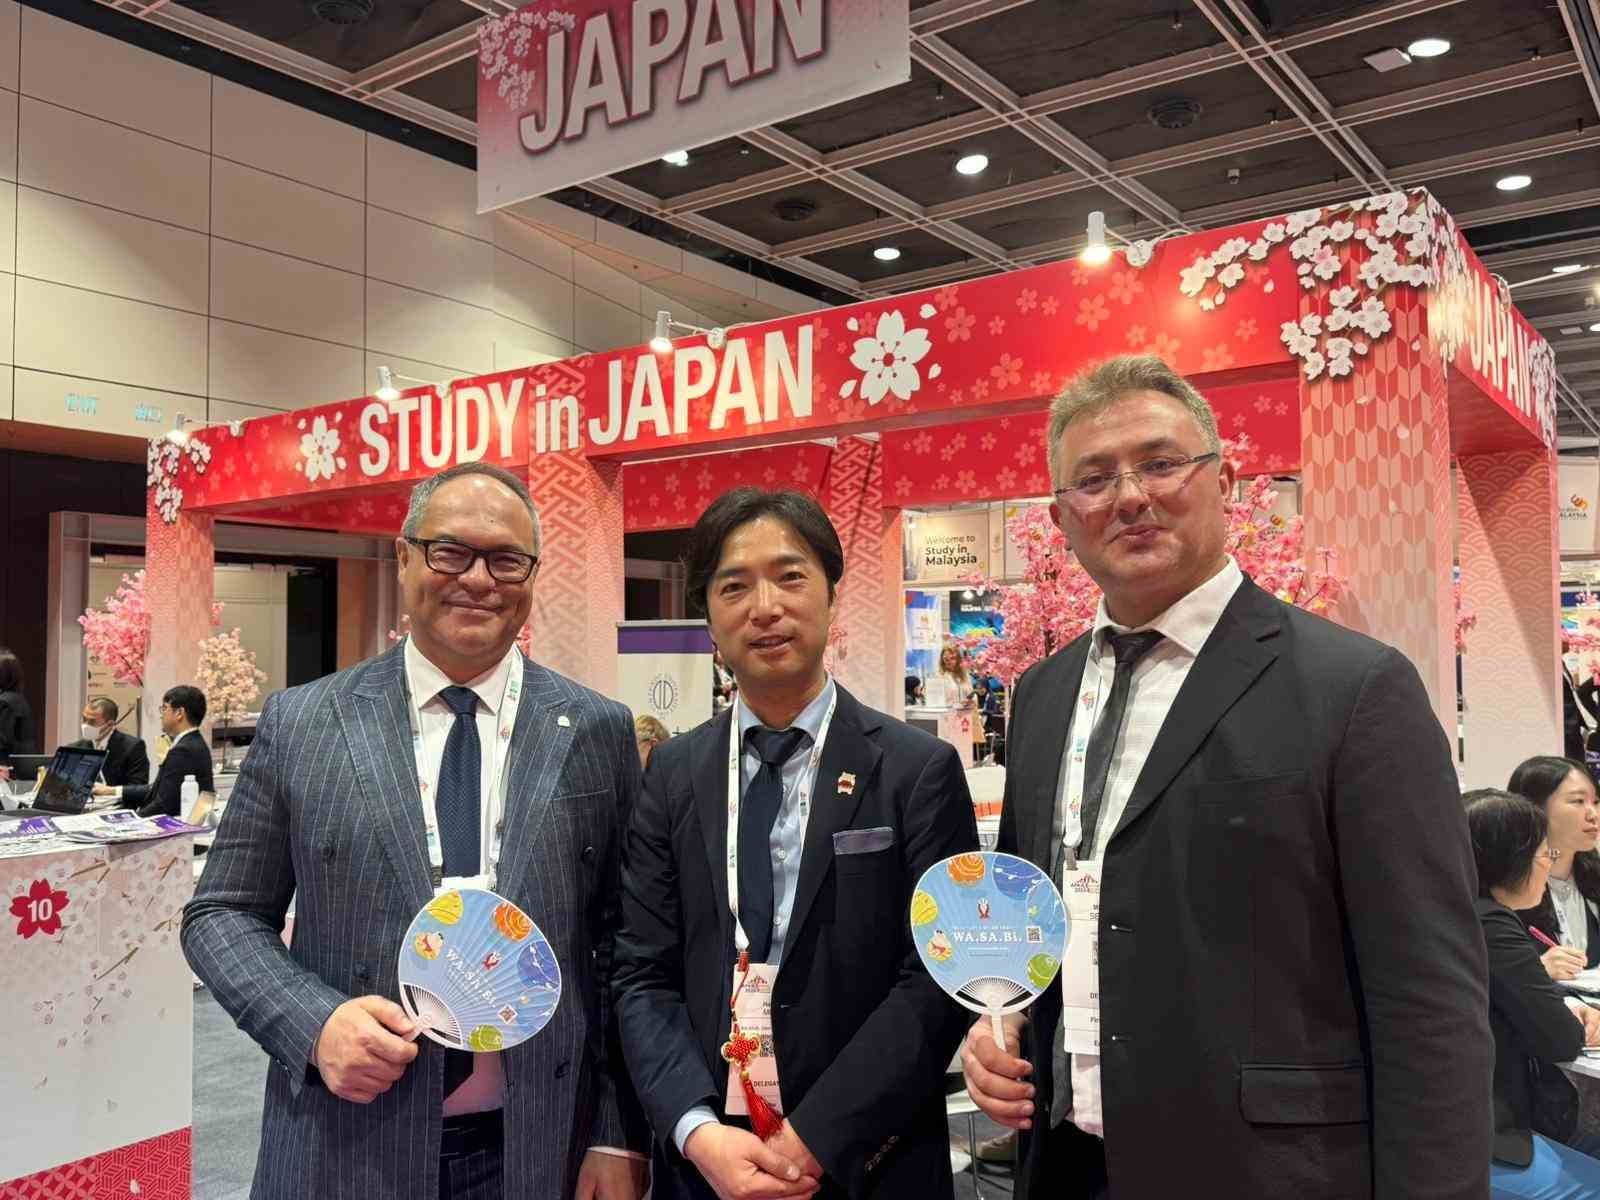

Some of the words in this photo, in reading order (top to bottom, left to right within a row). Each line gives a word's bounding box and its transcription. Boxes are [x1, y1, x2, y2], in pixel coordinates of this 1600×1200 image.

[519, 0, 823, 152] JAPAN
[360, 378, 526, 476] STUDY
[536, 385, 579, 453] in
[588, 325, 814, 445] JAPAN
[925, 535, 965, 544] Welcome
[925, 545, 955, 556] Study
[958, 544, 967, 552] in
[926, 553, 977, 566] Malaysia
[28, 898, 53, 923] 10
